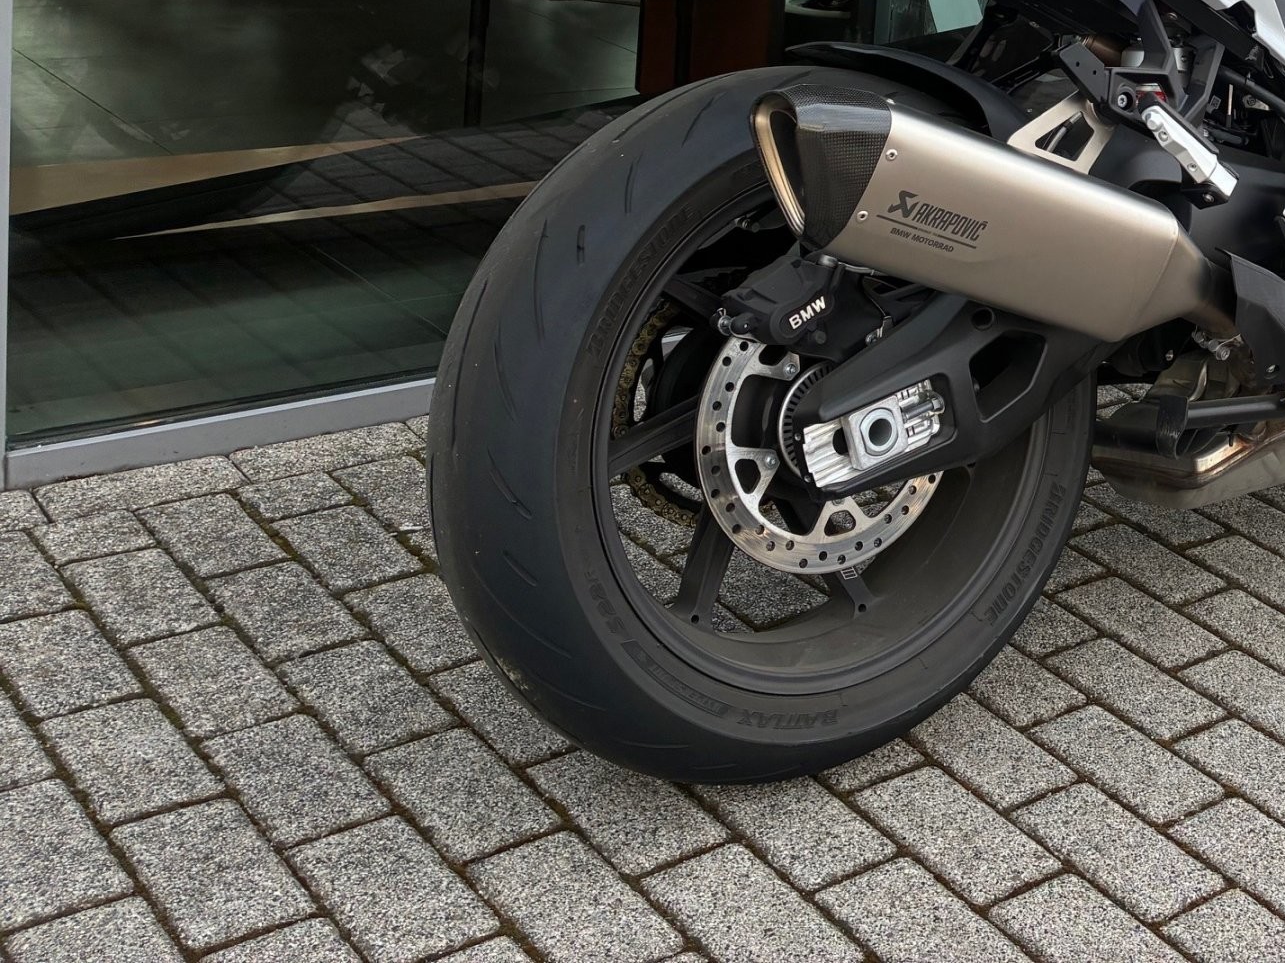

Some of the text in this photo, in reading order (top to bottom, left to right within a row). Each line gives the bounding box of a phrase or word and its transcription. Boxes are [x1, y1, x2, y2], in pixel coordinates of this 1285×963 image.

[890, 227, 912, 240] BMW
[913, 233, 954, 253] MOTORRAD
[788, 296, 827, 330] BMW
[983, 483, 1067, 626] BRIDGESTONE
